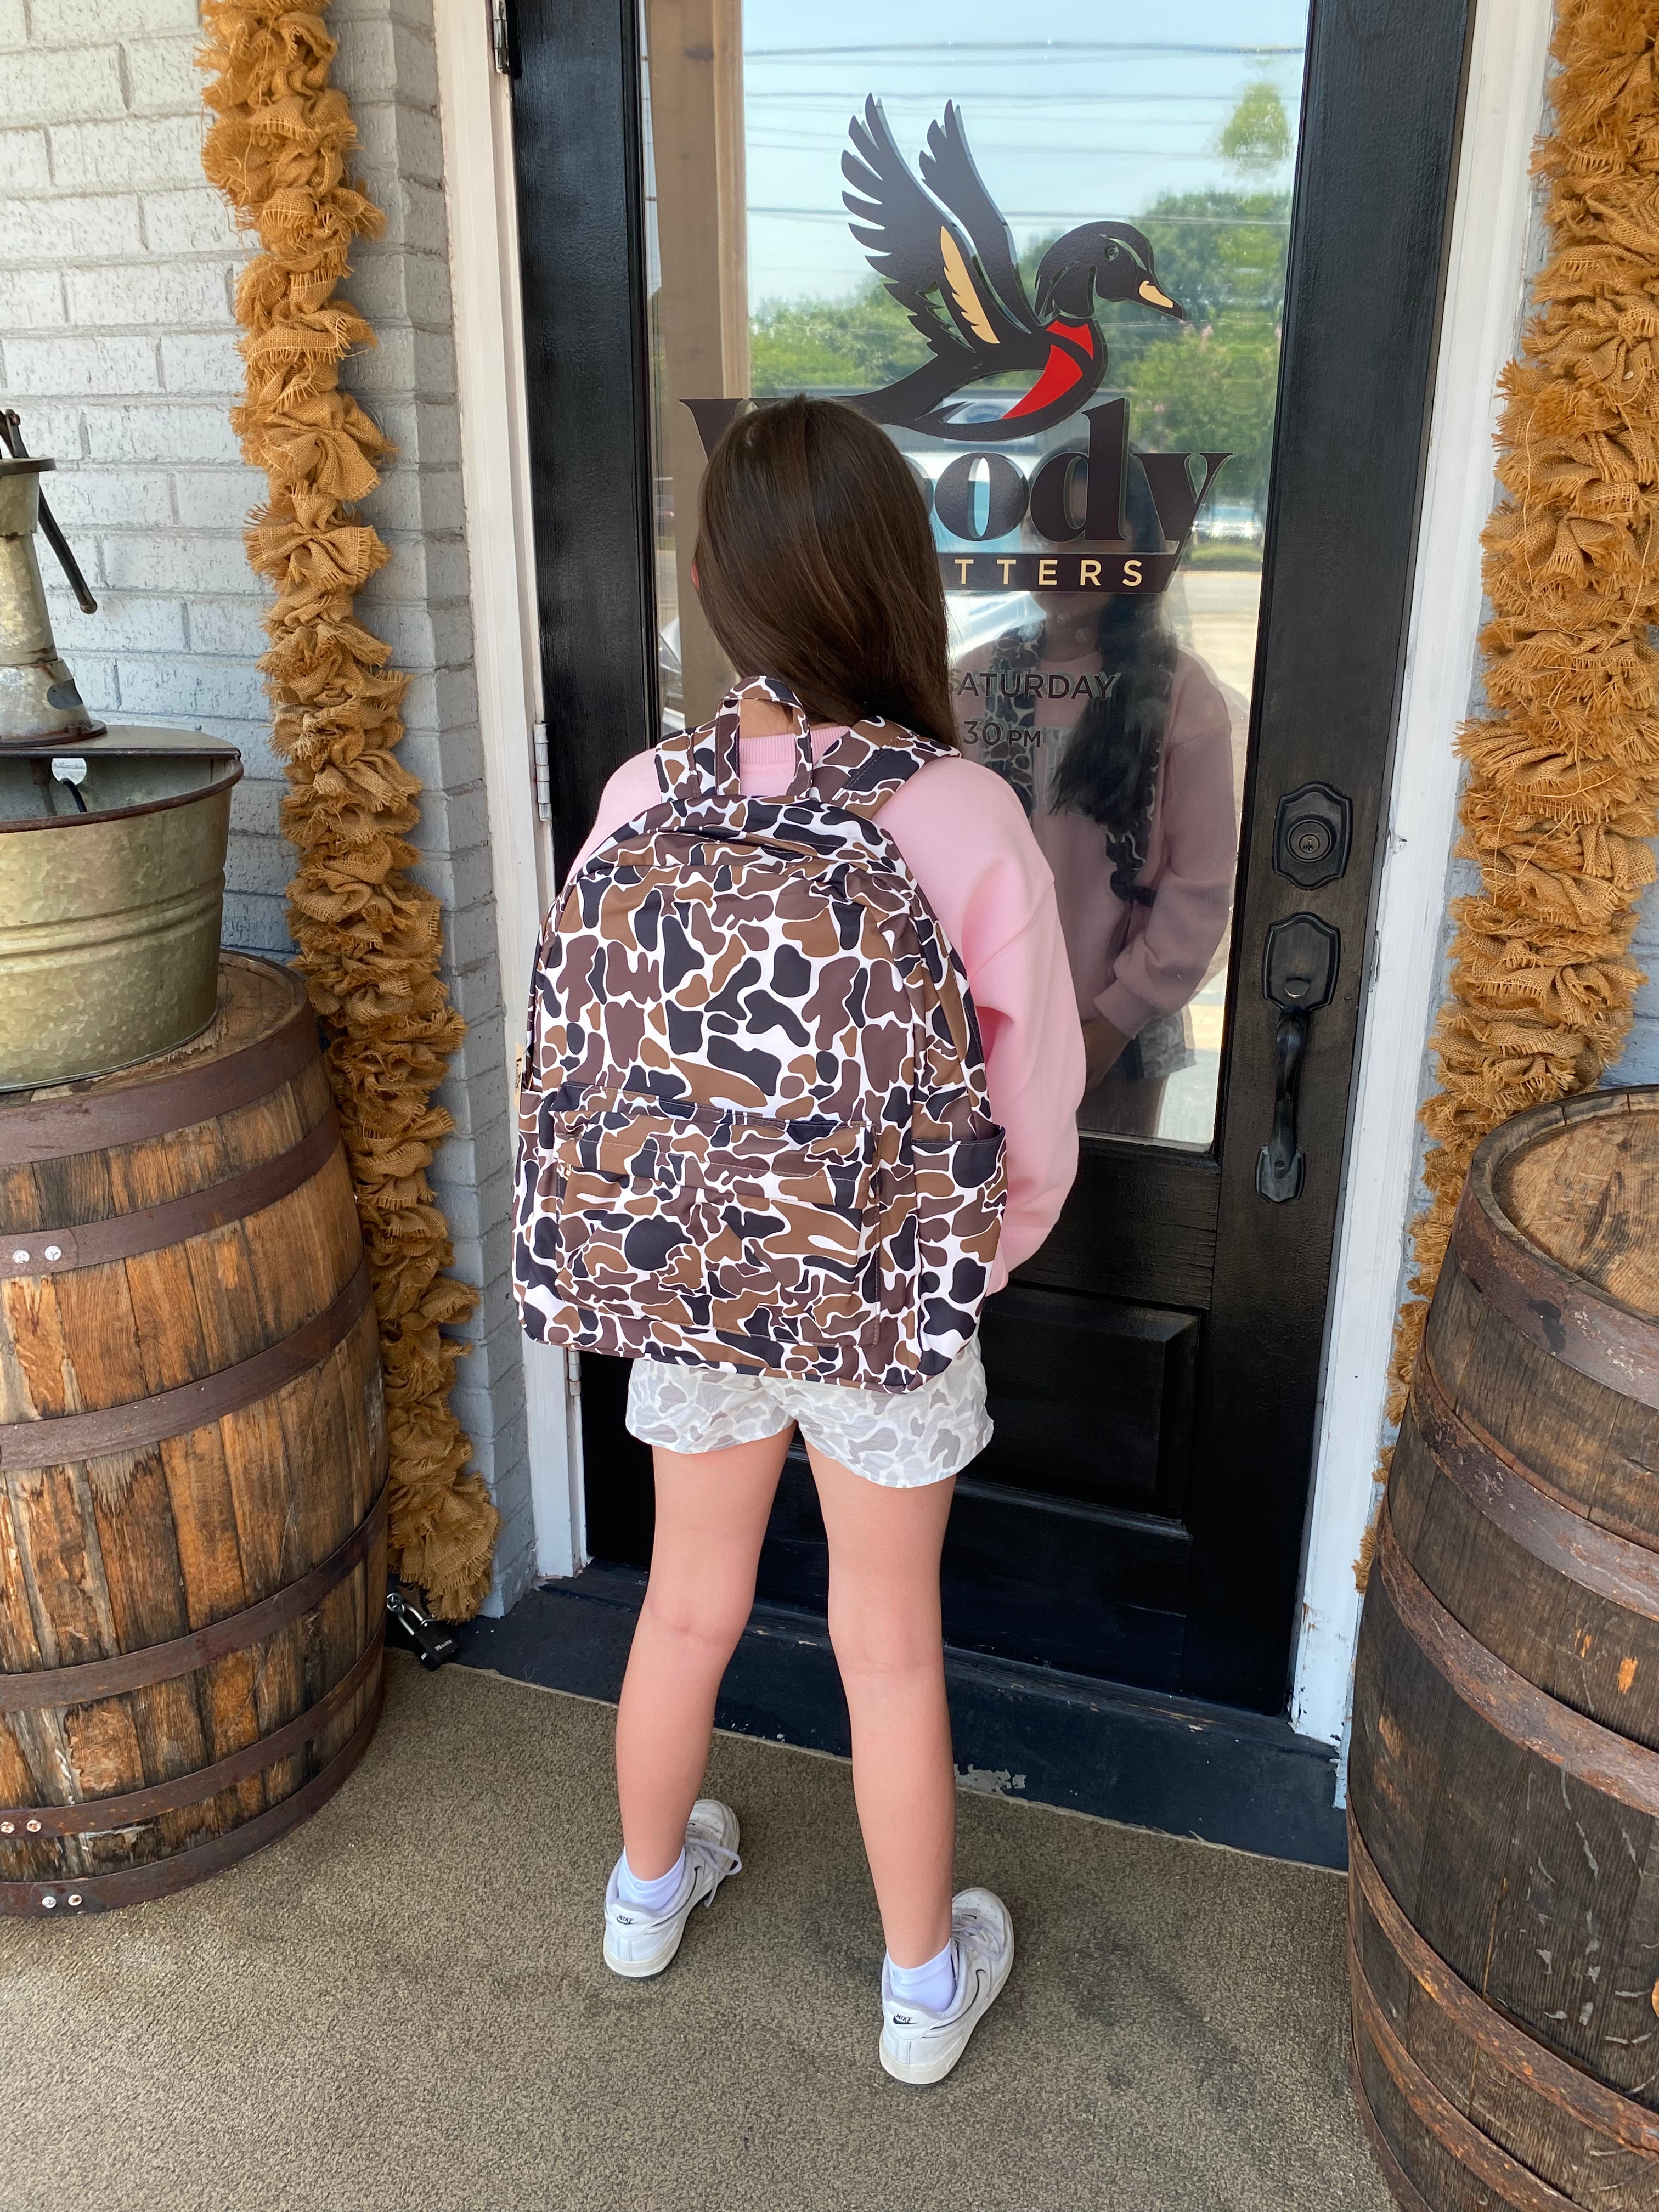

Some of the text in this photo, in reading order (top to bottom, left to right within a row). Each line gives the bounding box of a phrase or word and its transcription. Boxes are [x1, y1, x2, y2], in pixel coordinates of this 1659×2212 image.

[955, 558, 1142, 587] TTERS
[947, 672, 1116, 700] ATURDAY
[962, 720, 1041, 748] 30 PM
[618, 1915, 634, 1924] NIKE
[896, 2013, 913, 2024] NIKE
